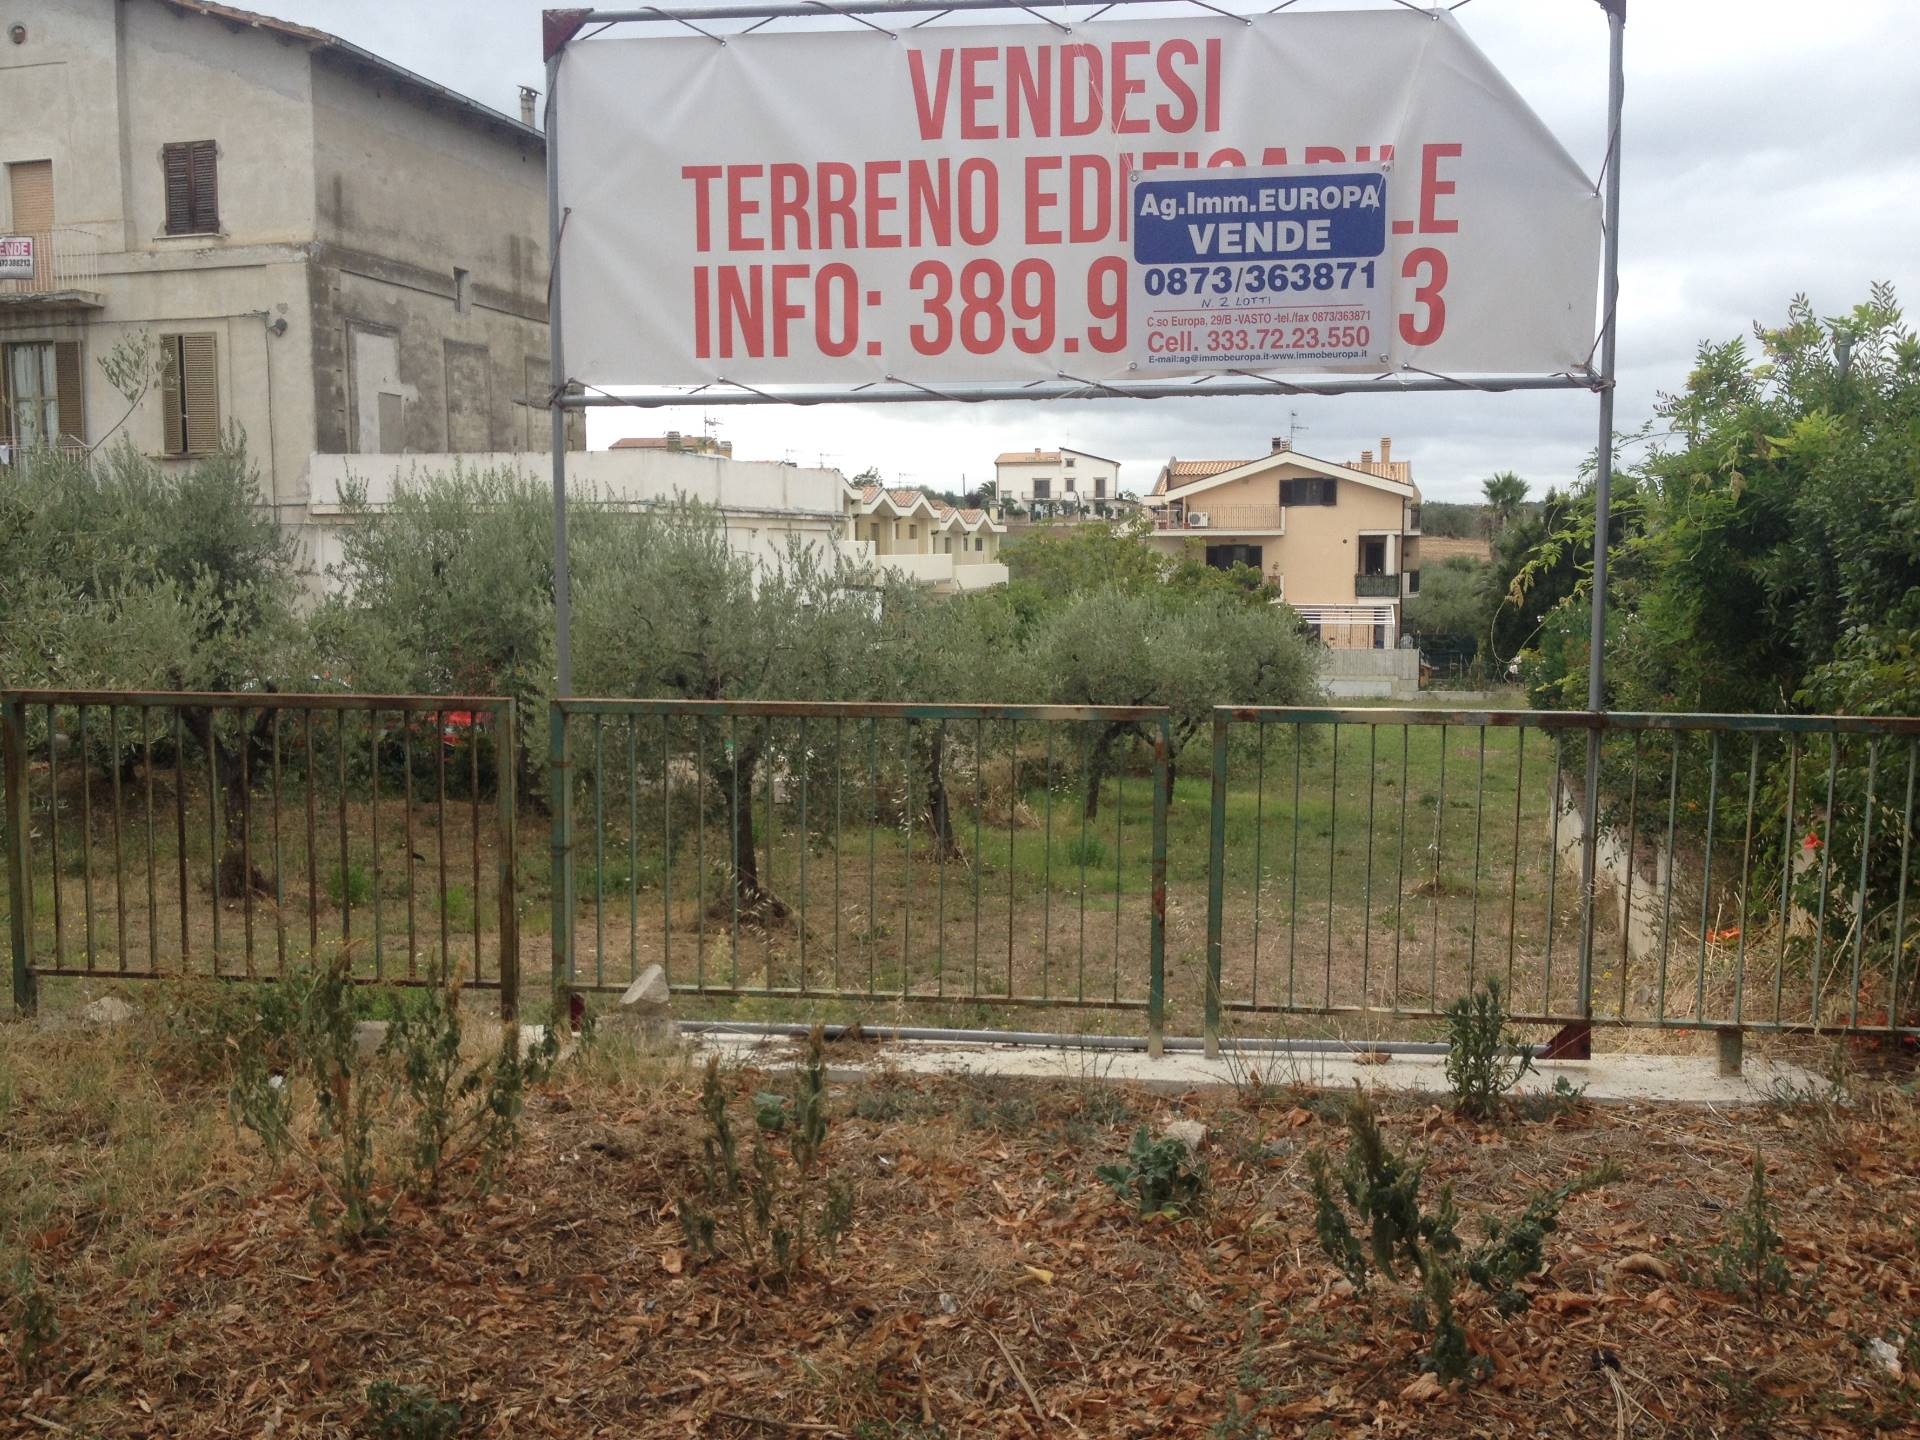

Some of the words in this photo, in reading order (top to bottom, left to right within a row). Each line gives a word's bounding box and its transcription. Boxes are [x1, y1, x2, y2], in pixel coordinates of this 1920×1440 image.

[907, 38, 1221, 141] VENDESI
[681, 157, 999, 252] TERRENO
[1139, 184, 1381, 220] Ag.Imm.EUROPA
[1187, 218, 1332, 255] VENDE
[1144, 260, 1376, 296] 0873/363871
[693, 262, 881, 359] INFO:
[1171, 315, 1208, 328] Europa,
[1210, 314, 1232, 326] 29/B
[1312, 310, 1371, 322] 0873/363871
[1219, 296, 1229, 307] 2
[1235, 295, 1271, 306] LOTTI
[1147, 330, 1199, 353] Cell.
[1207, 325, 1370, 352] 333.72.23.550
